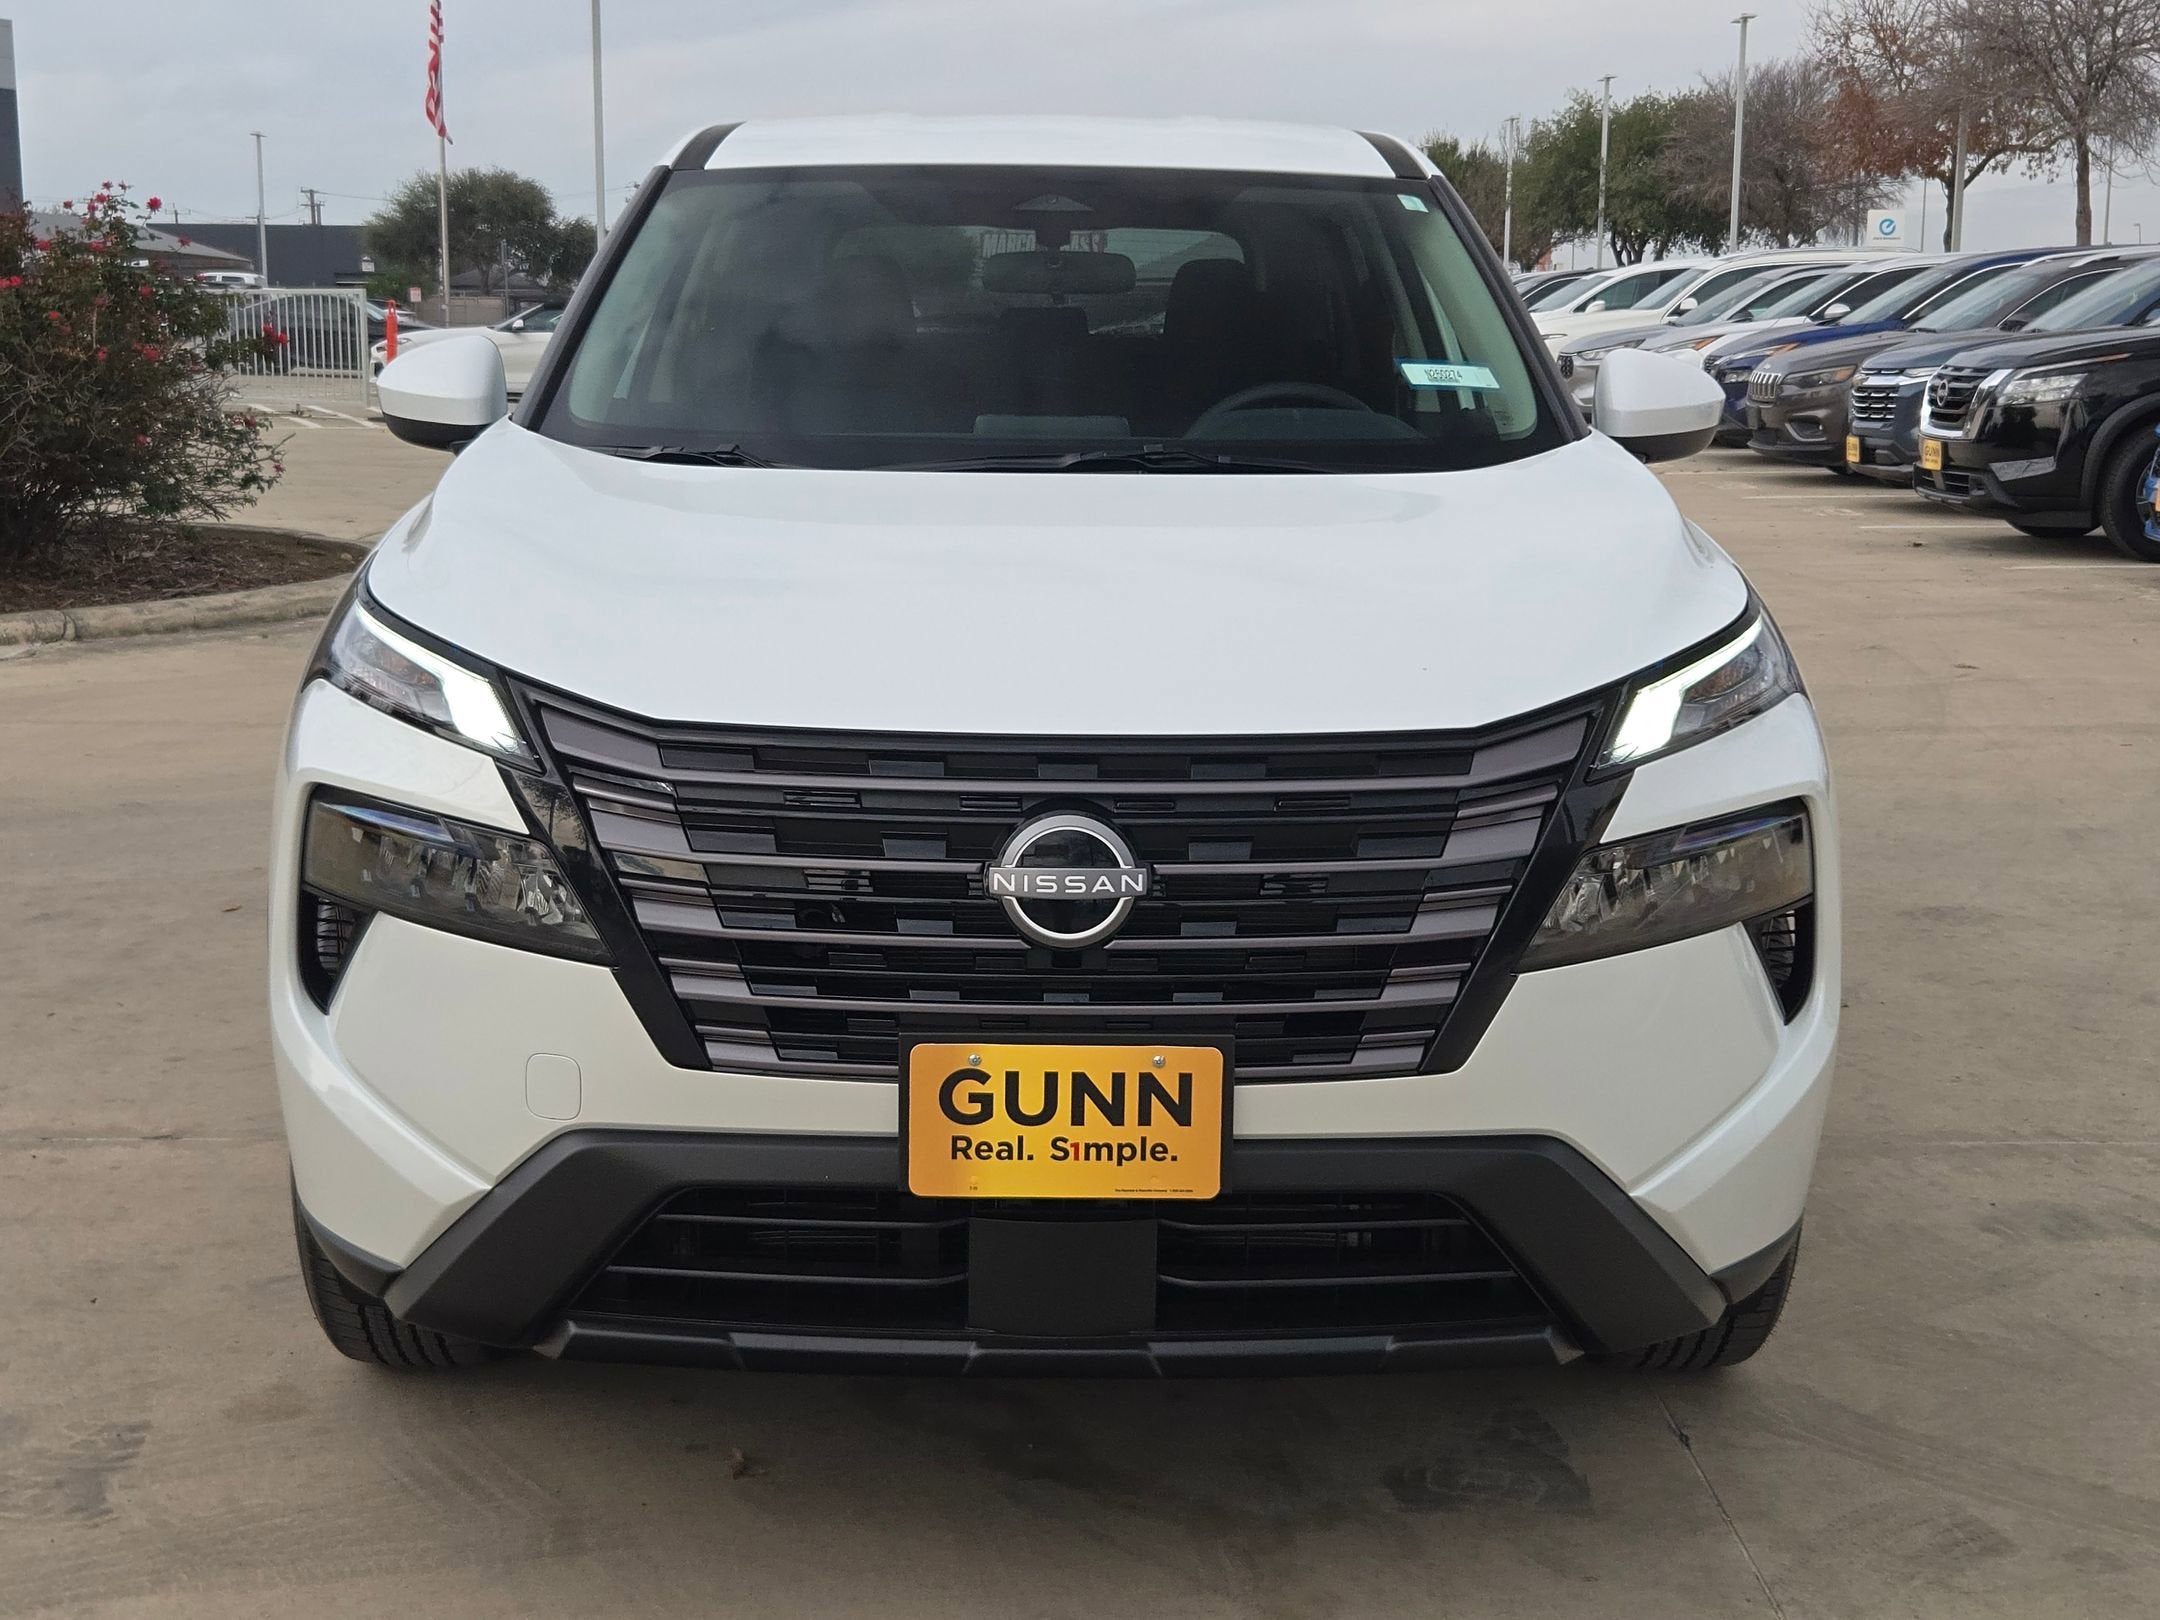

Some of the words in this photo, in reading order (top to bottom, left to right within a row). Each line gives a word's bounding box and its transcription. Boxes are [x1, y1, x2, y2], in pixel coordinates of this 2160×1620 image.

[993, 873, 1143, 894] NISSAN
[938, 1067, 1193, 1127] GUNN
[951, 1135, 1034, 1161] Real.
